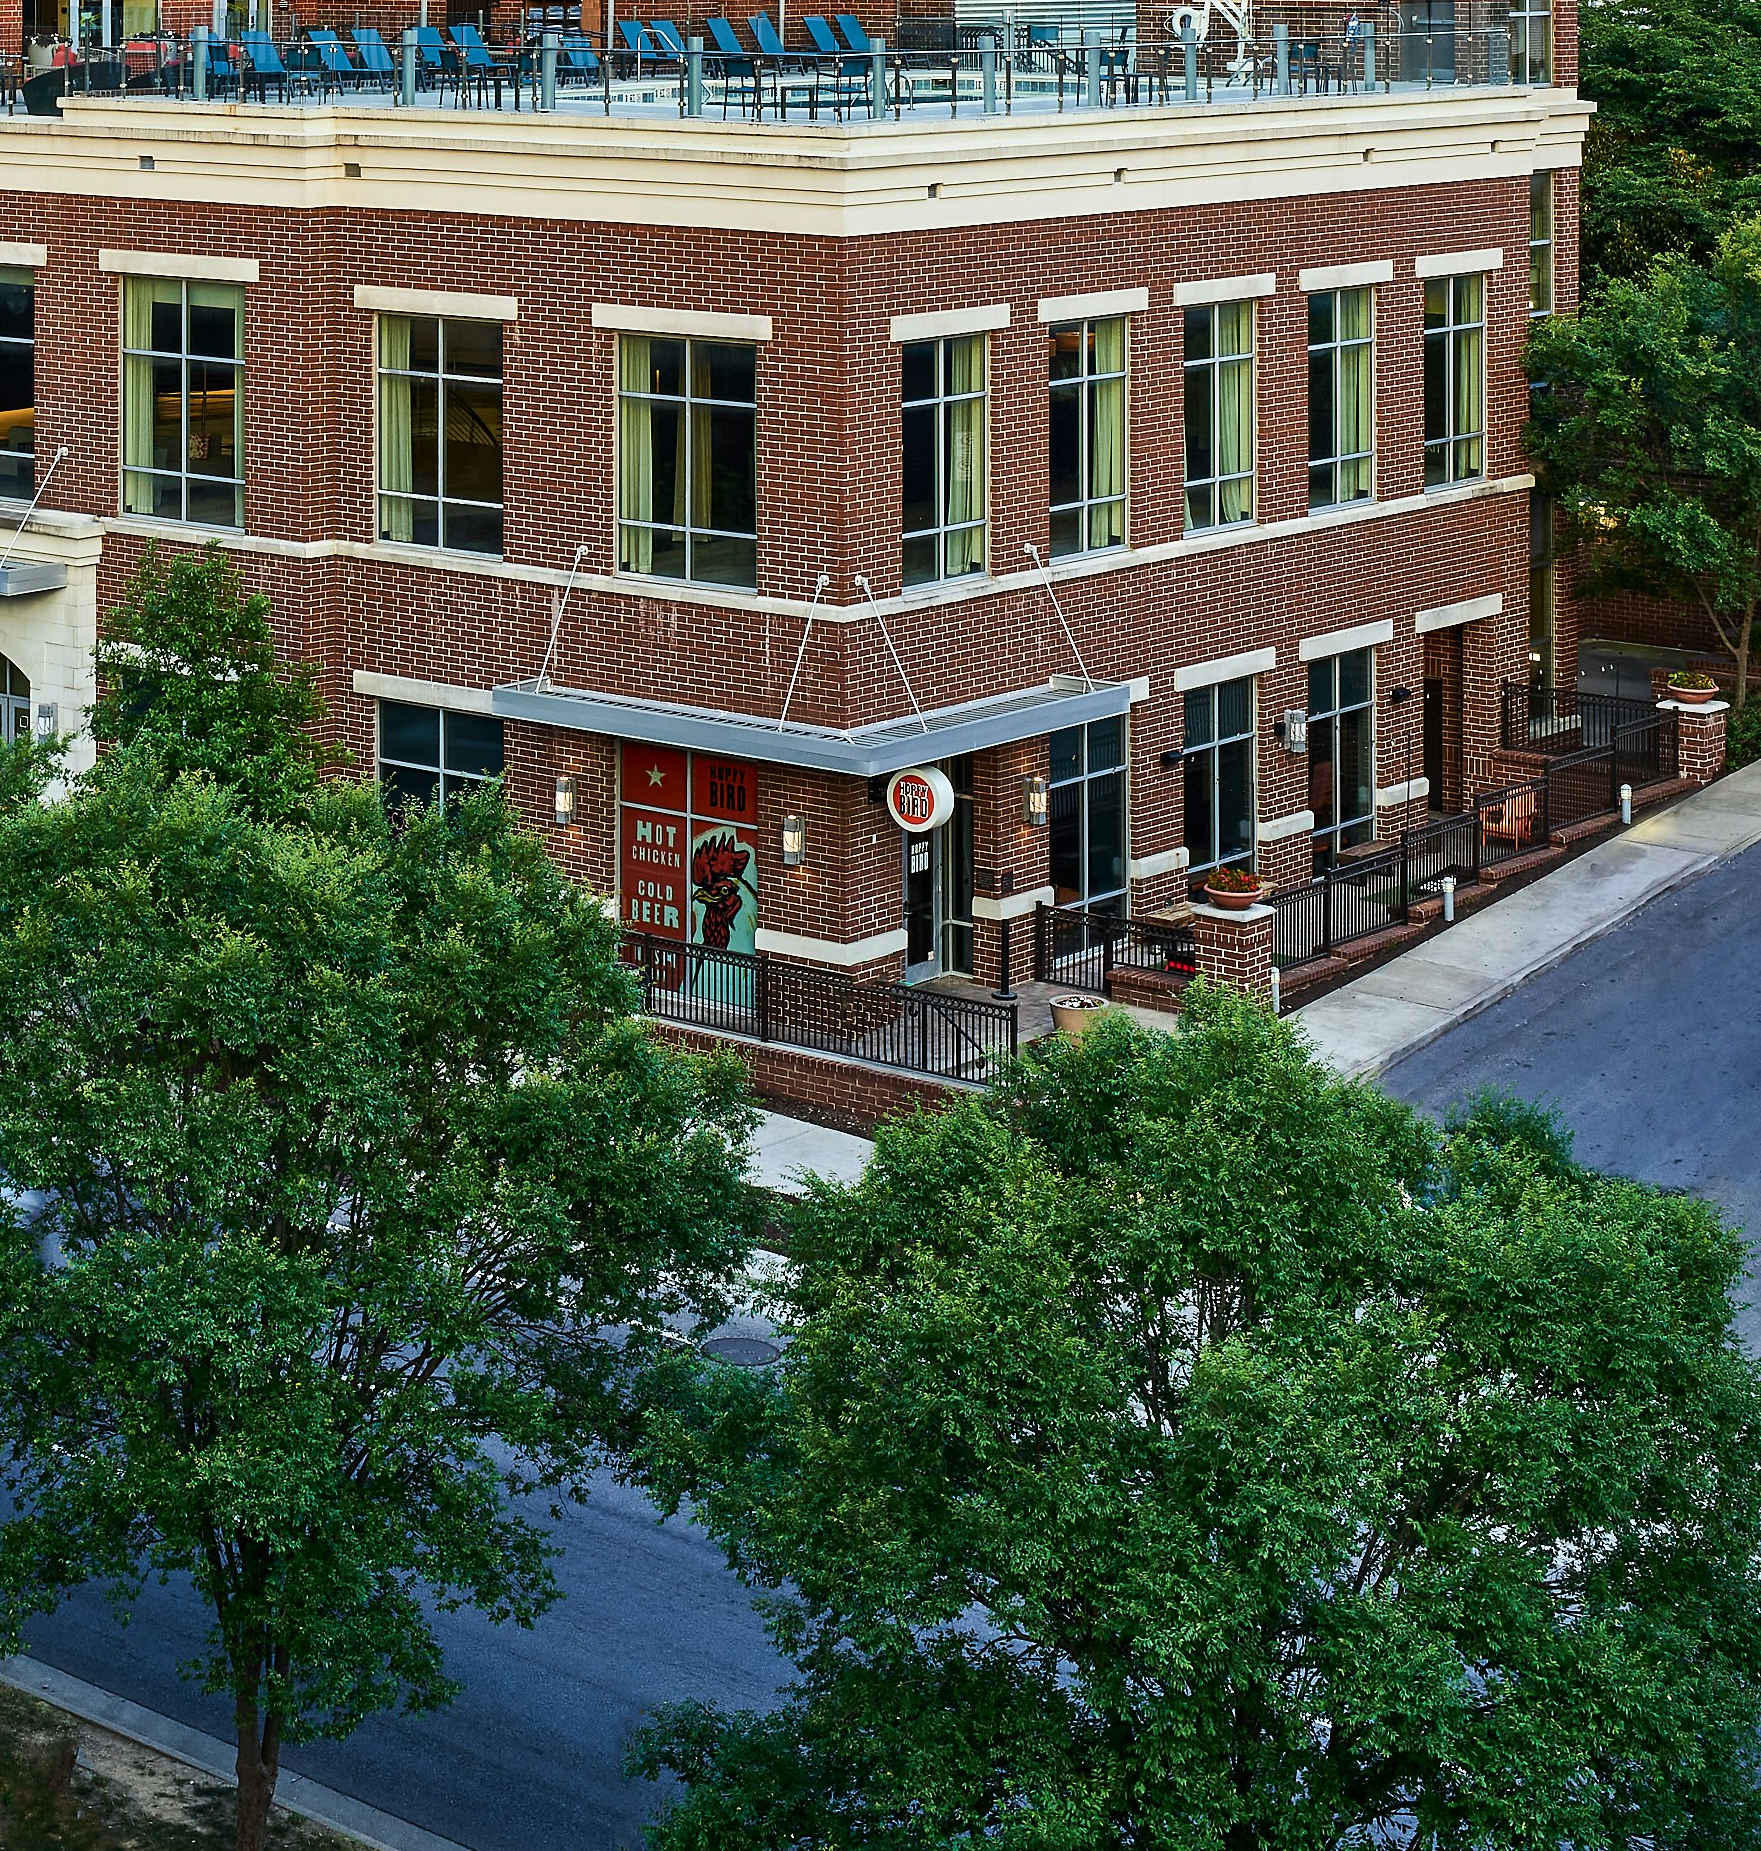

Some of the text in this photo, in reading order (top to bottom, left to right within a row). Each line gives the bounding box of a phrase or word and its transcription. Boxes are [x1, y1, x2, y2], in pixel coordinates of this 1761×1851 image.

[710, 765, 746, 785] HOPPY
[710, 781, 746, 812] BIRD
[899, 781, 929, 799] HOPPY
[900, 794, 929, 819] BIRD
[636, 819, 677, 848] HOT
[632, 845, 680, 868] CHICKEN
[911, 841, 929, 855] HOPPY
[911, 852, 929, 874] BIRD
[638, 880, 673, 902] COLD
[631, 898, 679, 929] BEER
